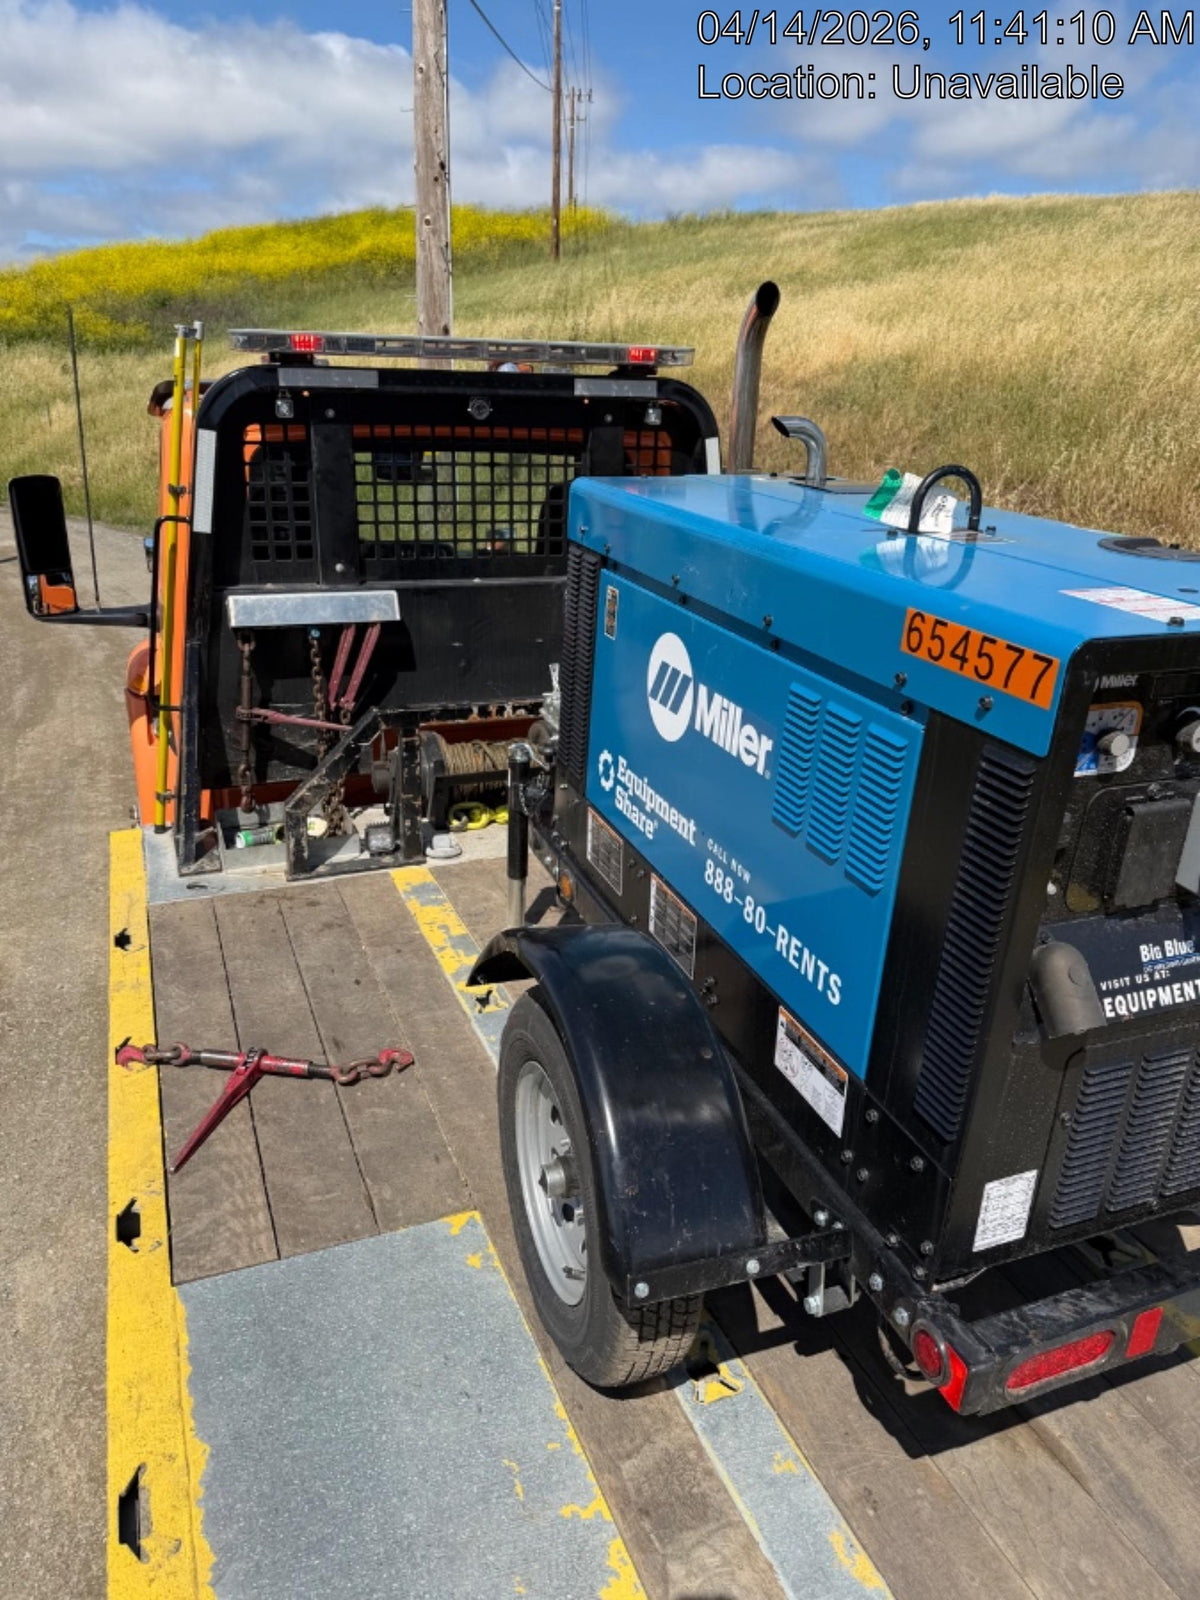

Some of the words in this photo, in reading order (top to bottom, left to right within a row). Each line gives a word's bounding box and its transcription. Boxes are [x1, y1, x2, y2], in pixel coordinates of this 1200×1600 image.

[906, 611, 1054, 700] 654577
[1100, 674, 1139, 689] Miller
[694, 683, 773, 776] Miller
[617, 755, 697, 847] Equipment
[706, 838, 728, 865] CALL
[730, 858, 752, 884] NOW
[704, 858, 843, 1006] 888-80-RENTS
[1139, 944, 1163, 962] Big
[1164, 938, 1196, 957] Blue
[1099, 976, 1131, 992] VISIT
[1135, 973, 1150, 984] US
[1153, 969, 1171, 981] AT:
